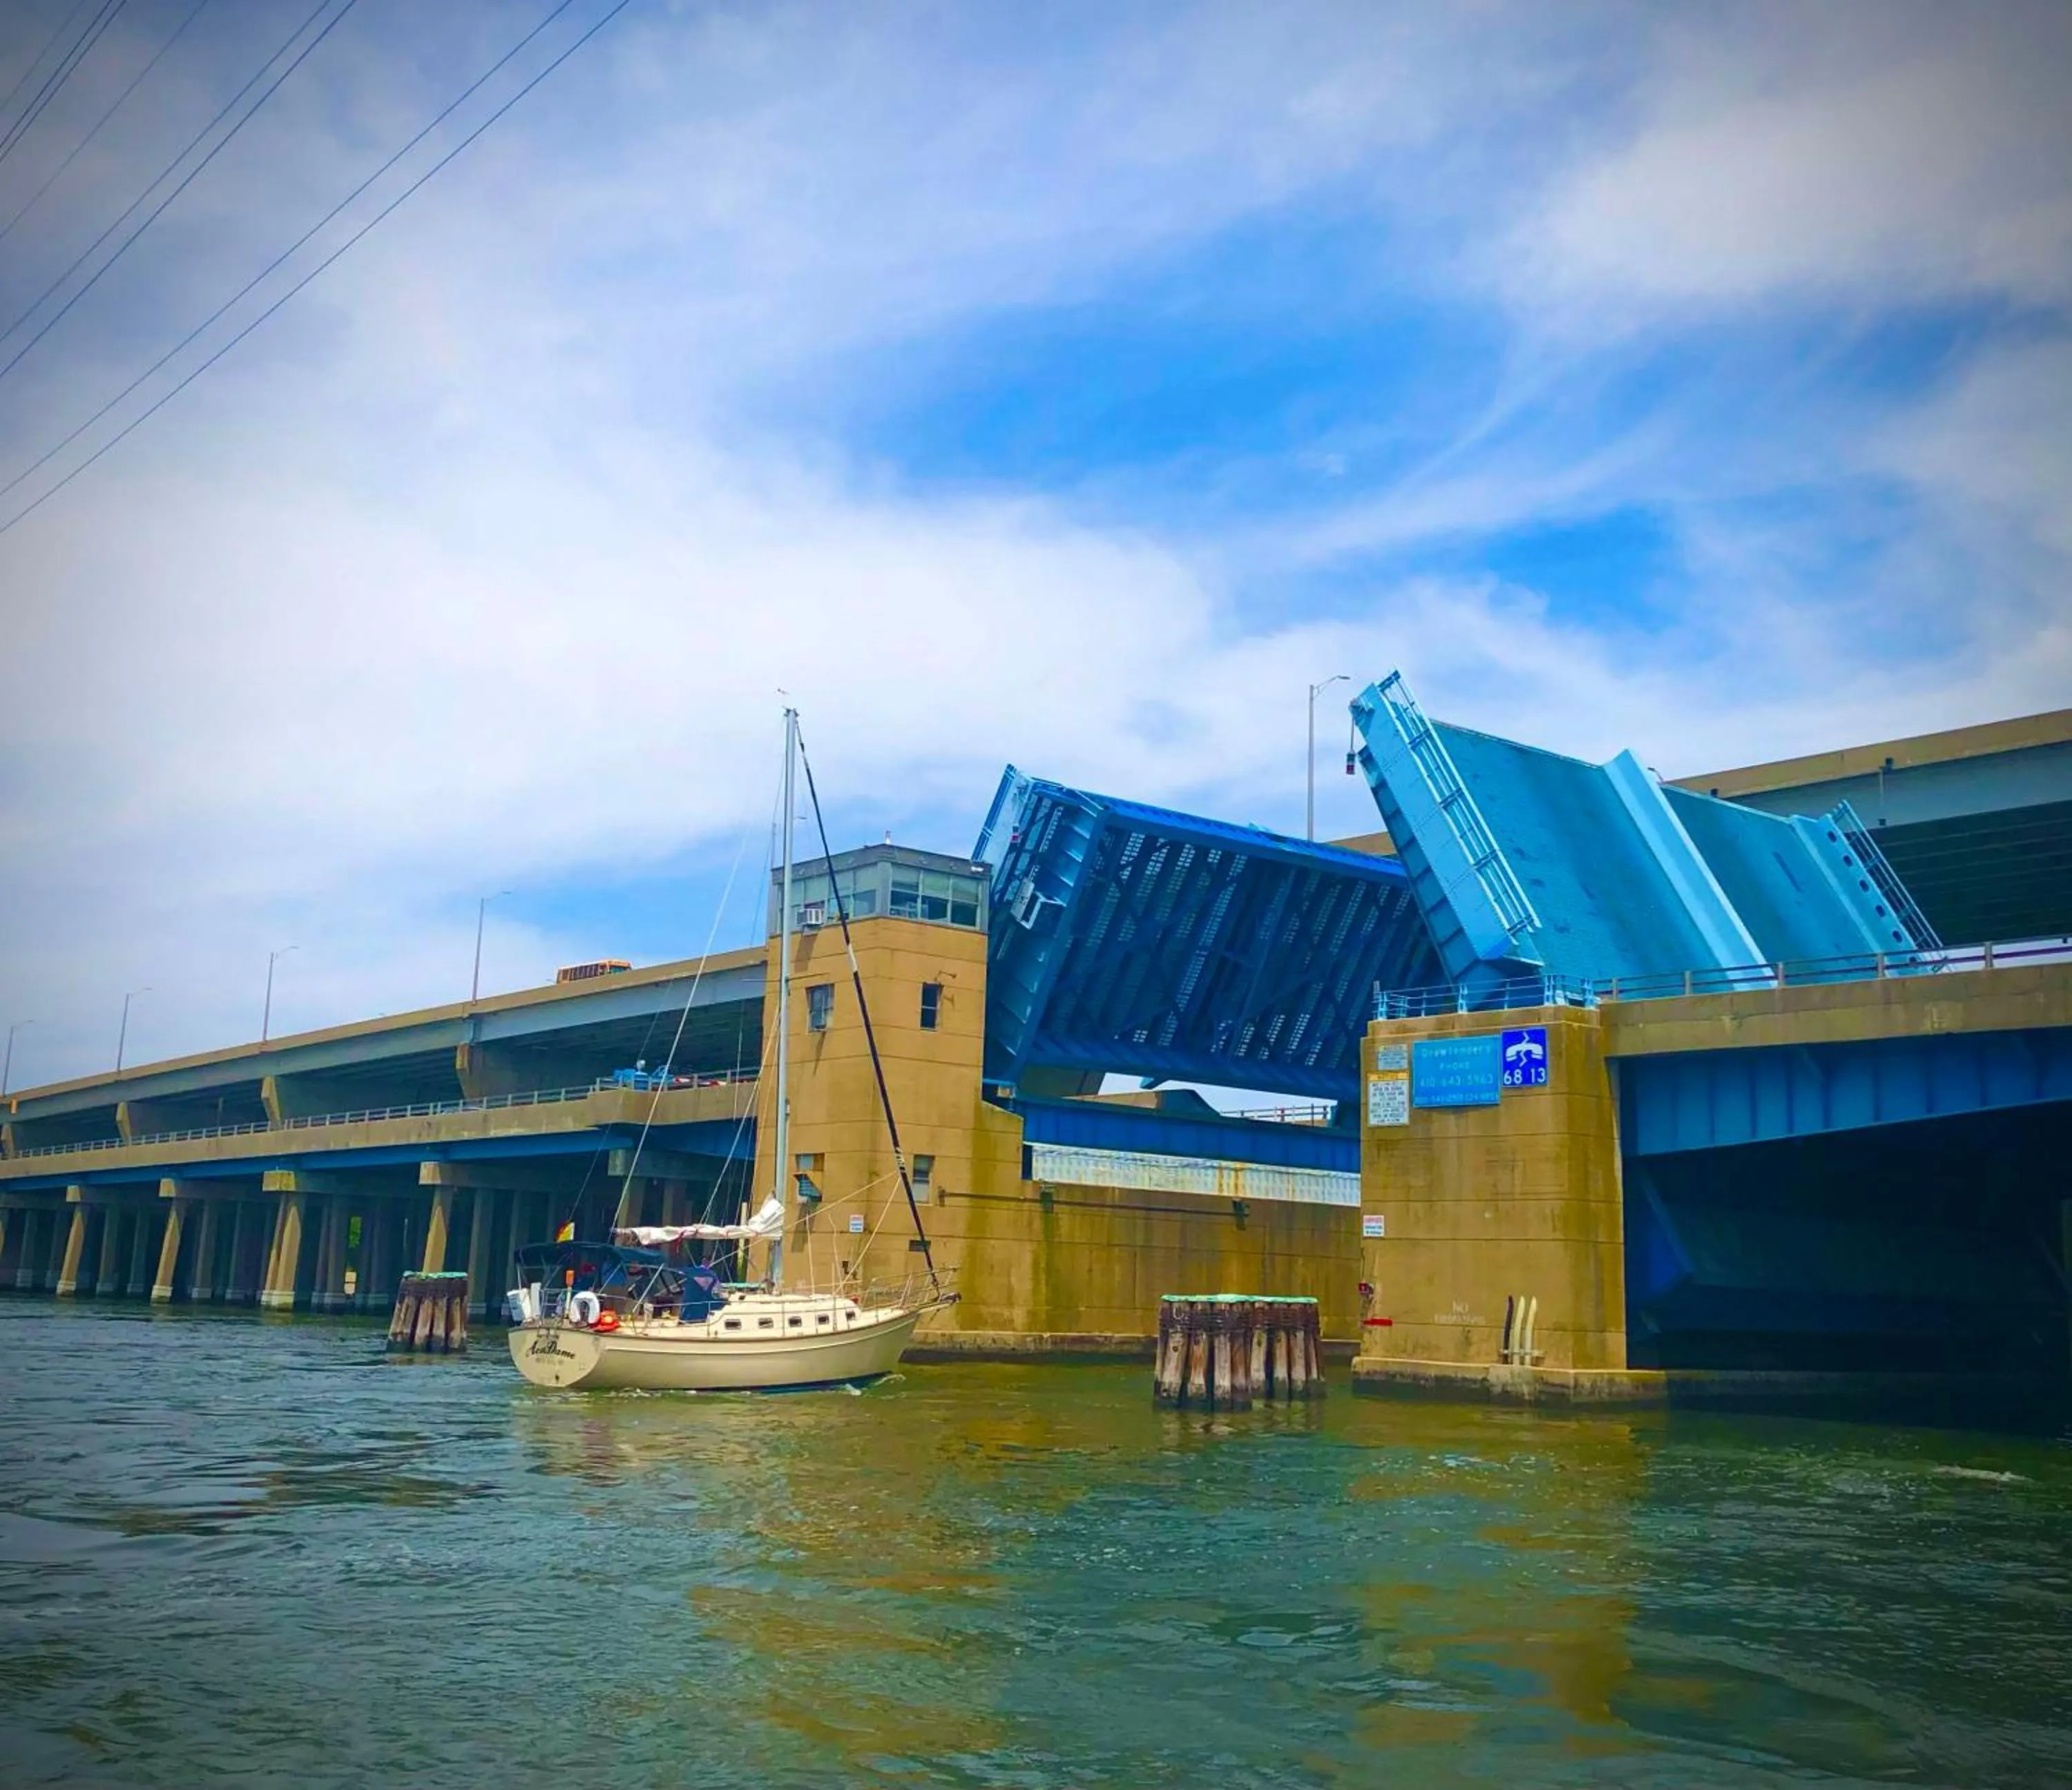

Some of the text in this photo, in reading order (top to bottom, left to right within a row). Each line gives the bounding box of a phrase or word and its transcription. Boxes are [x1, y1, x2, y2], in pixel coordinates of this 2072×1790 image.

[1439, 1061, 1470, 1070] PHONE
[1504, 1067, 1546, 1084] 68 13
